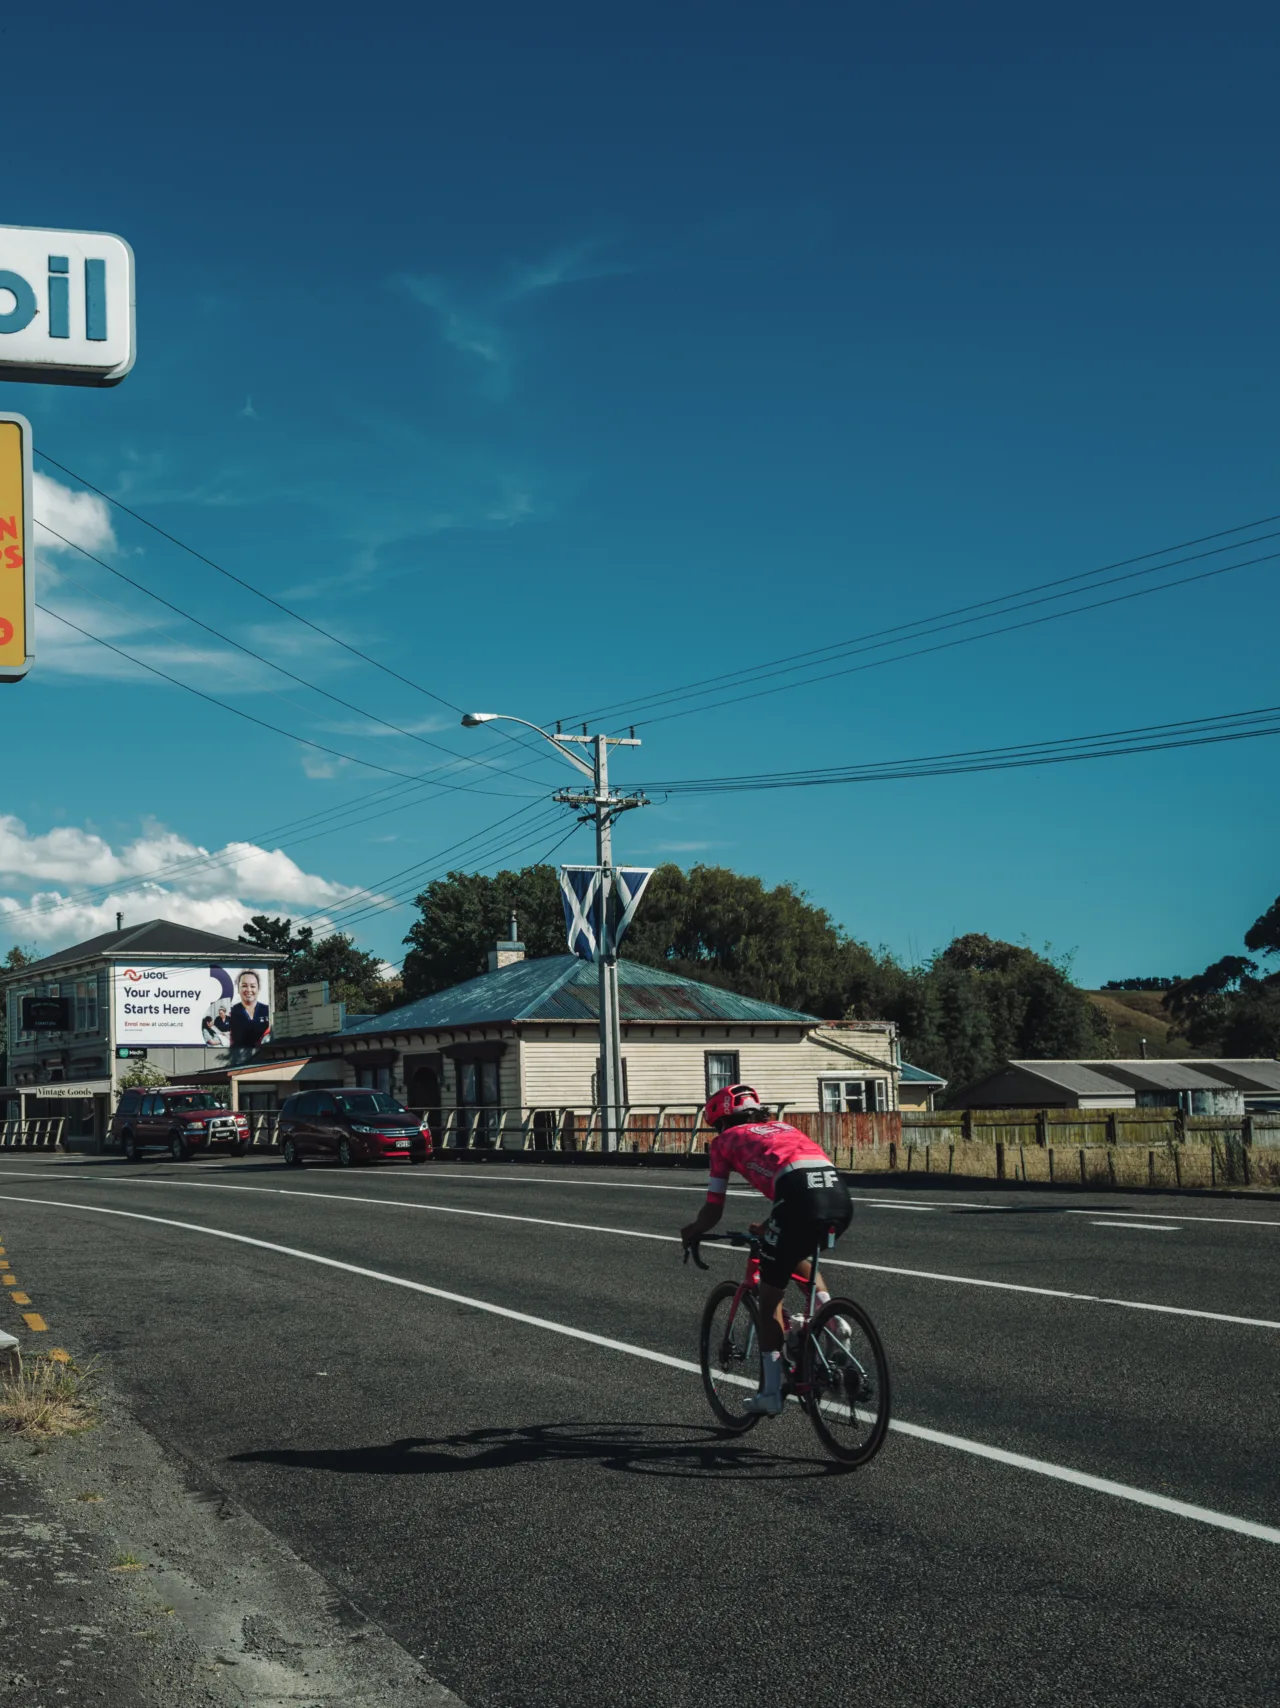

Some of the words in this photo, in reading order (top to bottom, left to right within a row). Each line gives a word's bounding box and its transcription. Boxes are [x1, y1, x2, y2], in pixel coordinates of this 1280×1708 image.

[124, 987, 150, 997] Your
[154, 987, 201, 1001] Journey
[124, 1003, 160, 1014] Starts
[163, 1004, 191, 1014] Here
[38, 1087, 66, 1097] Vintage
[67, 1088, 92, 1096] Goods
[806, 1171, 839, 1189] EF
